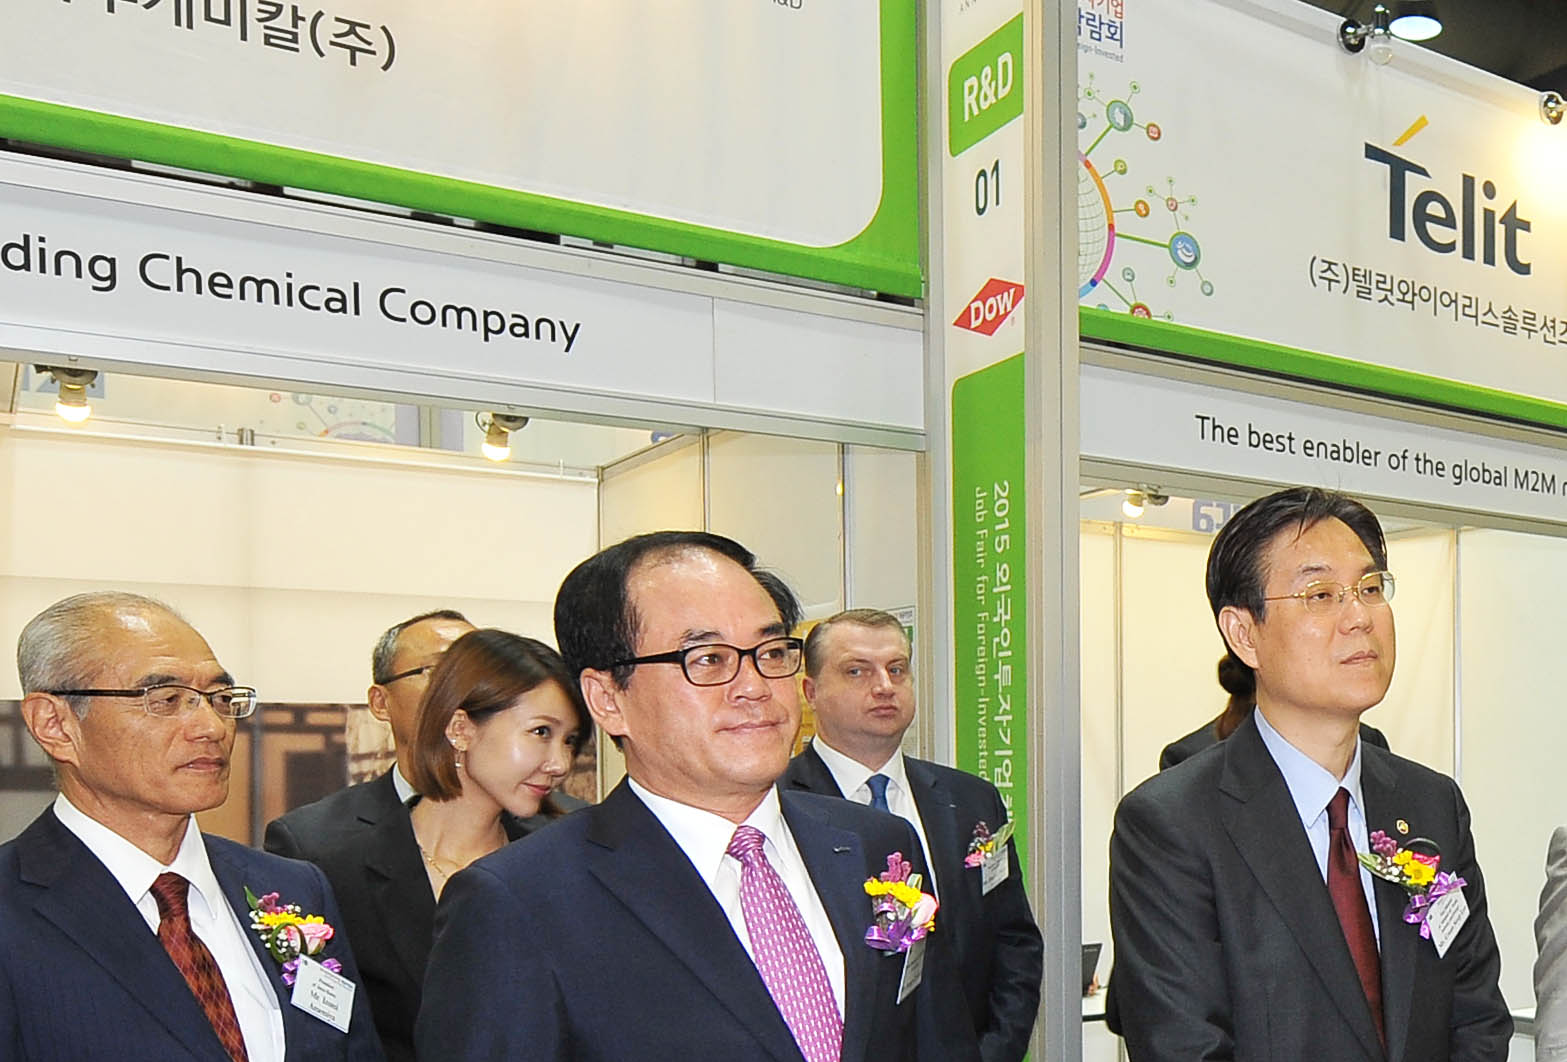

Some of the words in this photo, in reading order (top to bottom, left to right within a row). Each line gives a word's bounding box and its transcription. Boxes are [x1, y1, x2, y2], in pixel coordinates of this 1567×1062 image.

[963, 51, 1013, 122] R&D
[974, 158, 1001, 216] 01
[1364, 118, 1532, 276] Telit
[137, 251, 361, 316] Chemical
[378, 287, 582, 353] Company
[1195, 415, 1239, 445] The
[1248, 424, 1296, 455] best
[1303, 436, 1380, 467] enabler
[1388, 448, 1408, 471] of
[1415, 452, 1446, 478] the
[1452, 462, 1508, 487] global
[1514, 467, 1556, 495] M2M
[976, 487, 988, 523] Job
[994, 480, 1010, 553] 2015
[976, 528, 989, 568] Fair
[976, 575, 989, 604] for
[993, 563, 1014, 788] 외국인투자기업
